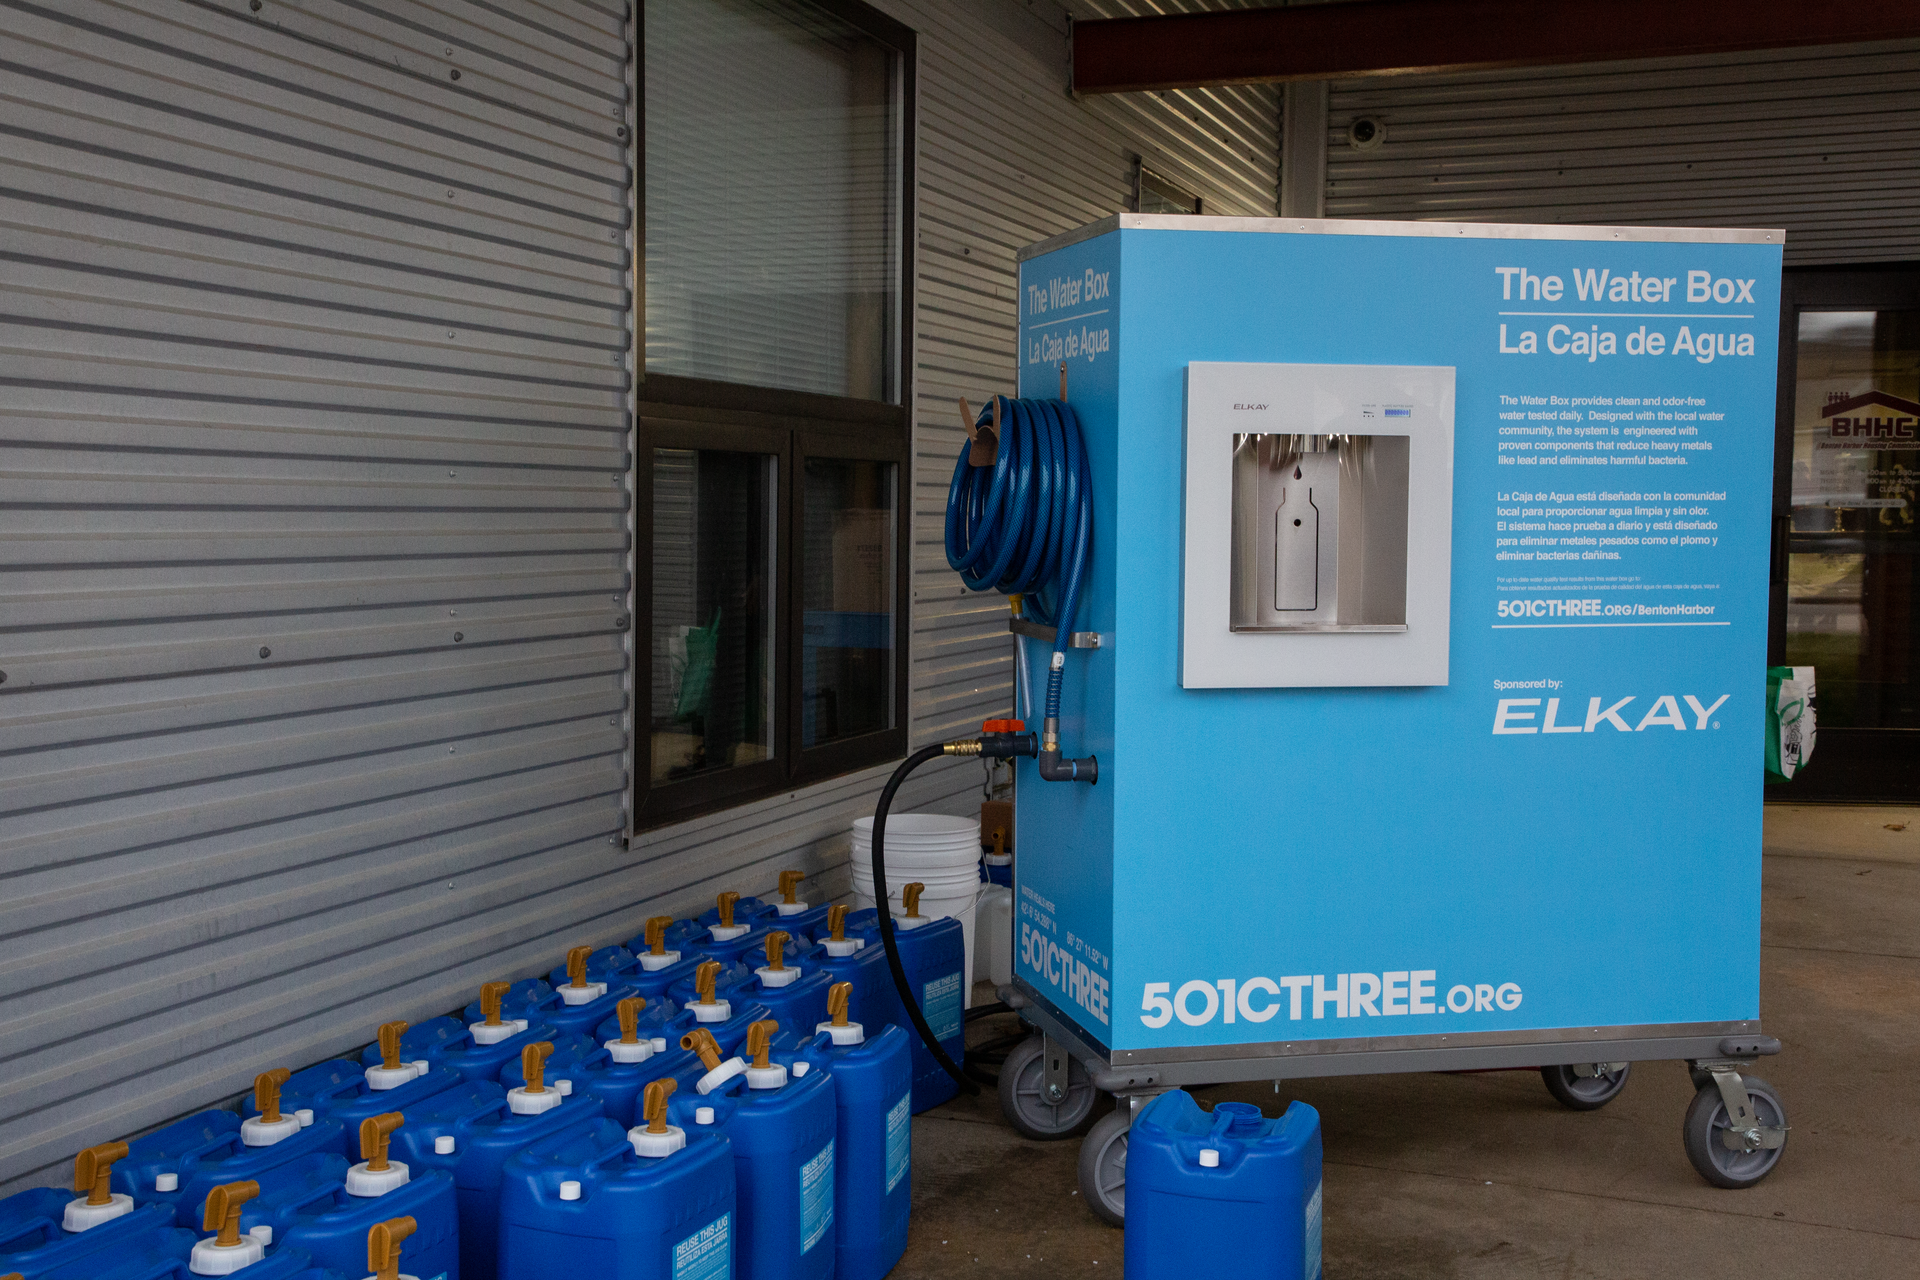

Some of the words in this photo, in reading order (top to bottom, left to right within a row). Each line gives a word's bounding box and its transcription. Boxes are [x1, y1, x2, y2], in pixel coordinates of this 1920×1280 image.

[1028, 284, 1047, 315] The
[1050, 276, 1082, 310] Water
[1085, 268, 1109, 301] Box
[1496, 267, 1564, 301] The
[1573, 268, 1676, 302] Water
[1686, 270, 1756, 303] Box
[1029, 338, 1039, 364] La
[1042, 332, 1062, 368] Caja
[1065, 329, 1078, 358] de
[1080, 326, 1109, 362] Agua
[1500, 324, 1537, 354] La
[1547, 324, 1617, 362] Caja
[1626, 326, 1666, 355] de
[1672, 326, 1754, 364] Agua
[1500, 395, 1518, 405] The
[1520, 395, 1548, 405] Water
[1550, 396, 1569, 405] Box
[1572, 396, 1612, 407] provides
[1615, 396, 1640, 406] clean
[1642, 396, 1660, 406] and
[1662, 396, 1706, 406] odor-free
[1500, 410, 1526, 420] water
[1528, 411, 1557, 420] tested
[1560, 411, 1584, 422] daily.
[1589, 411, 1633, 422] Designed
[1636, 411, 1655, 420] with
[1658, 411, 1672, 421] the
[1674, 411, 1696, 421] local
[1699, 411, 1724, 421] water
[1499, 426, 1554, 437] community,
[1557, 426, 1572, 435] the
[1574, 426, 1608, 437] system
[1611, 426, 1619, 435] is
[1624, 426, 1676, 437] engineered
[1678, 426, 1698, 435] with
[1832, 418, 1913, 437] BHHC
[1498, 443, 1532, 452] proven
[1534, 440, 1594, 452] components
[1596, 440, 1614, 450] that
[1616, 440, 1649, 450] reduce
[1652, 440, 1679, 452] heavy
[1681, 440, 1712, 450] metals
[1498, 455, 1515, 465] like
[1517, 455, 1537, 465] lead
[1540, 455, 1557, 465] and
[1560, 455, 1608, 465] eliminates
[1610, 455, 1646, 465] harmful
[1648, 455, 1688, 465] bacteria.
[1498, 492, 1509, 502] La
[1512, 492, 1533, 503] Caja
[1536, 492, 1547, 501] de
[1550, 492, 1574, 503] Agua
[1577, 492, 1596, 501] está
[1598, 492, 1641, 501] diseñada
[1664, 492, 1672, 501] la
[1674, 492, 1726, 501] comunidad
[1497, 507, 1520, 516] local
[1522, 509, 1543, 518] para
[1546, 507, 1607, 518] proporcionar
[1609, 509, 1632, 518] agua
[1634, 507, 1662, 518] limpia
[1665, 508, 1670, 518] y
[1673, 506, 1687, 515] sin
[1689, 506, 1709, 515] olor.
[1497, 522, 1506, 531] El
[1509, 522, 1546, 531] sistema
[1548, 522, 1571, 531] hace
[1574, 522, 1606, 533] prueba
[1617, 522, 1643, 530] diario
[1645, 523, 1651, 532] y
[1653, 521, 1672, 530] está
[1675, 521, 1717, 530] diseñado
[1496, 539, 1518, 548] para
[1520, 537, 1558, 546] eliminar
[1560, 536, 1597, 546] metales
[1599, 536, 1639, 547] pesados
[1670, 536, 1678, 545] el
[1680, 536, 1710, 547] plomo
[1712, 538, 1718, 547] y
[1496, 552, 1534, 561] eliminar
[1536, 551, 1579, 560] bacterias
[1582, 551, 1621, 560] dañinas.
[1494, 680, 1546, 692] Sponsored
[1548, 679, 1563, 690] by:
[1053, 921, 1057, 935] N
[1102, 955, 1108, 970] W
[1021, 922, 1109, 1026] 501CTHREE
[1140, 970, 1523, 1029] 501CTHREE.ORG
[677, 1233, 699, 1257] REUSE
[700, 1224, 714, 1241] THIS
[715, 1215, 728, 1232] JUG
[677, 1249, 701, 1270] REUTILIZA
[701, 1241, 713, 1254] ESTA
